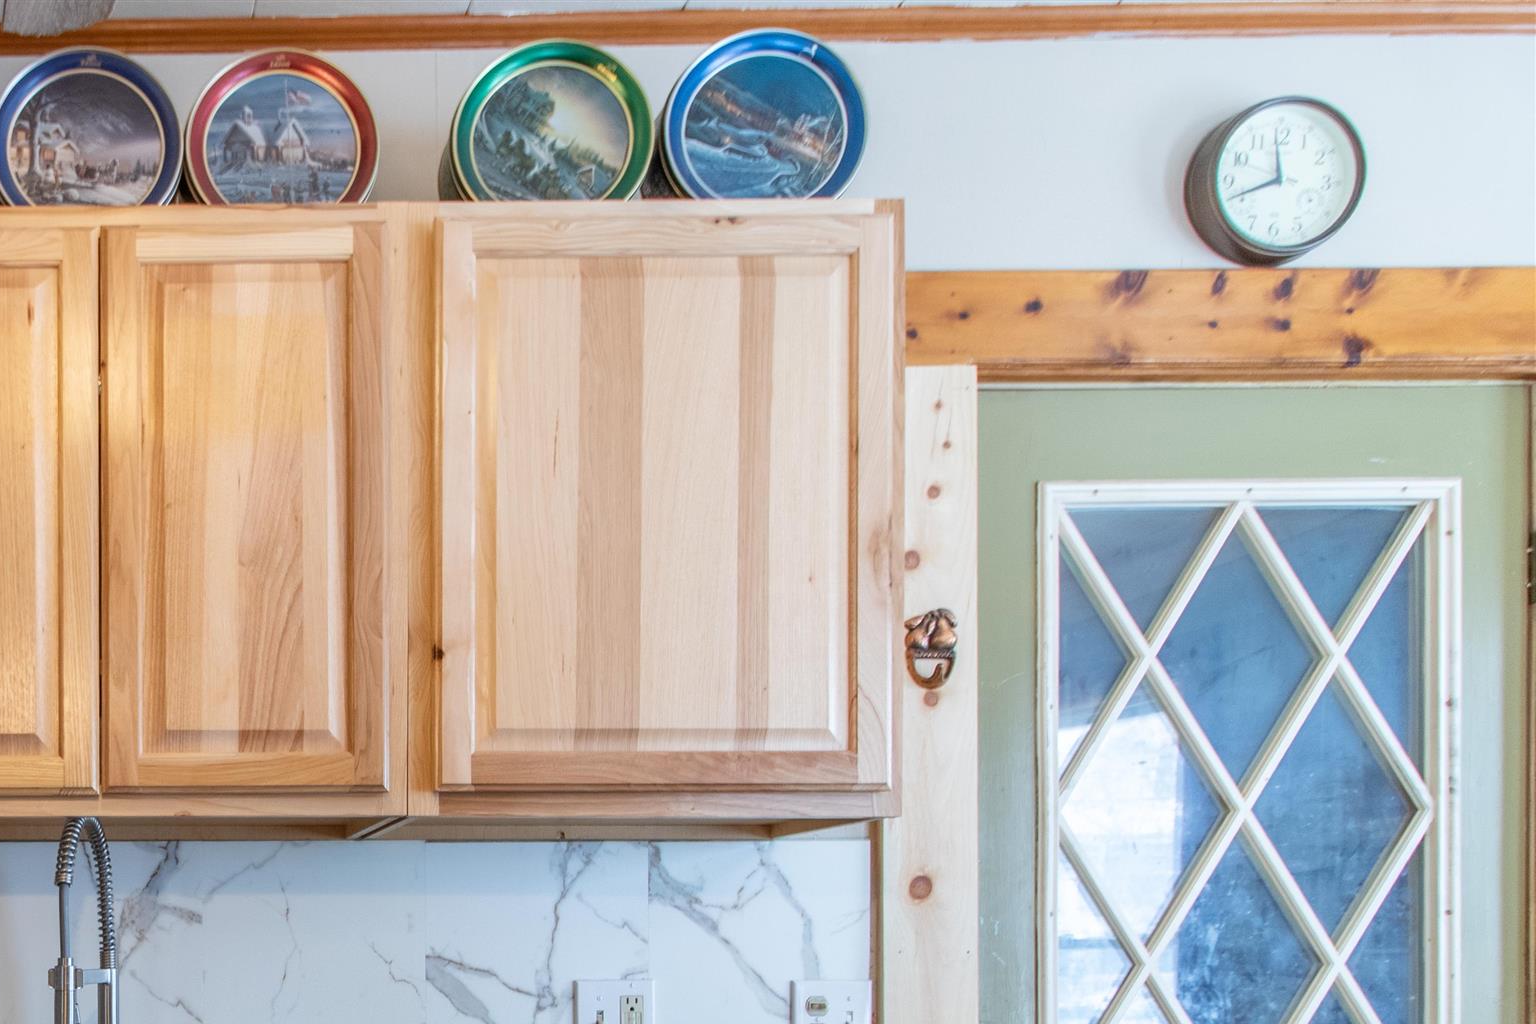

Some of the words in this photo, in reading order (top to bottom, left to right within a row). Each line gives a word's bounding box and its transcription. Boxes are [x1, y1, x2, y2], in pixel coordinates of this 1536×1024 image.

[1249, 134, 1265, 151] 11
[1300, 133, 1307, 150] 1
[1232, 151, 1249, 168] 10
[1314, 151, 1326, 166] 2
[1223, 174, 1235, 189] 9
[1320, 175, 1332, 191] 3
[1247, 215, 1257, 231] 7
[1267, 221, 1280, 238] 6
[1291, 216, 1303, 233] 5
